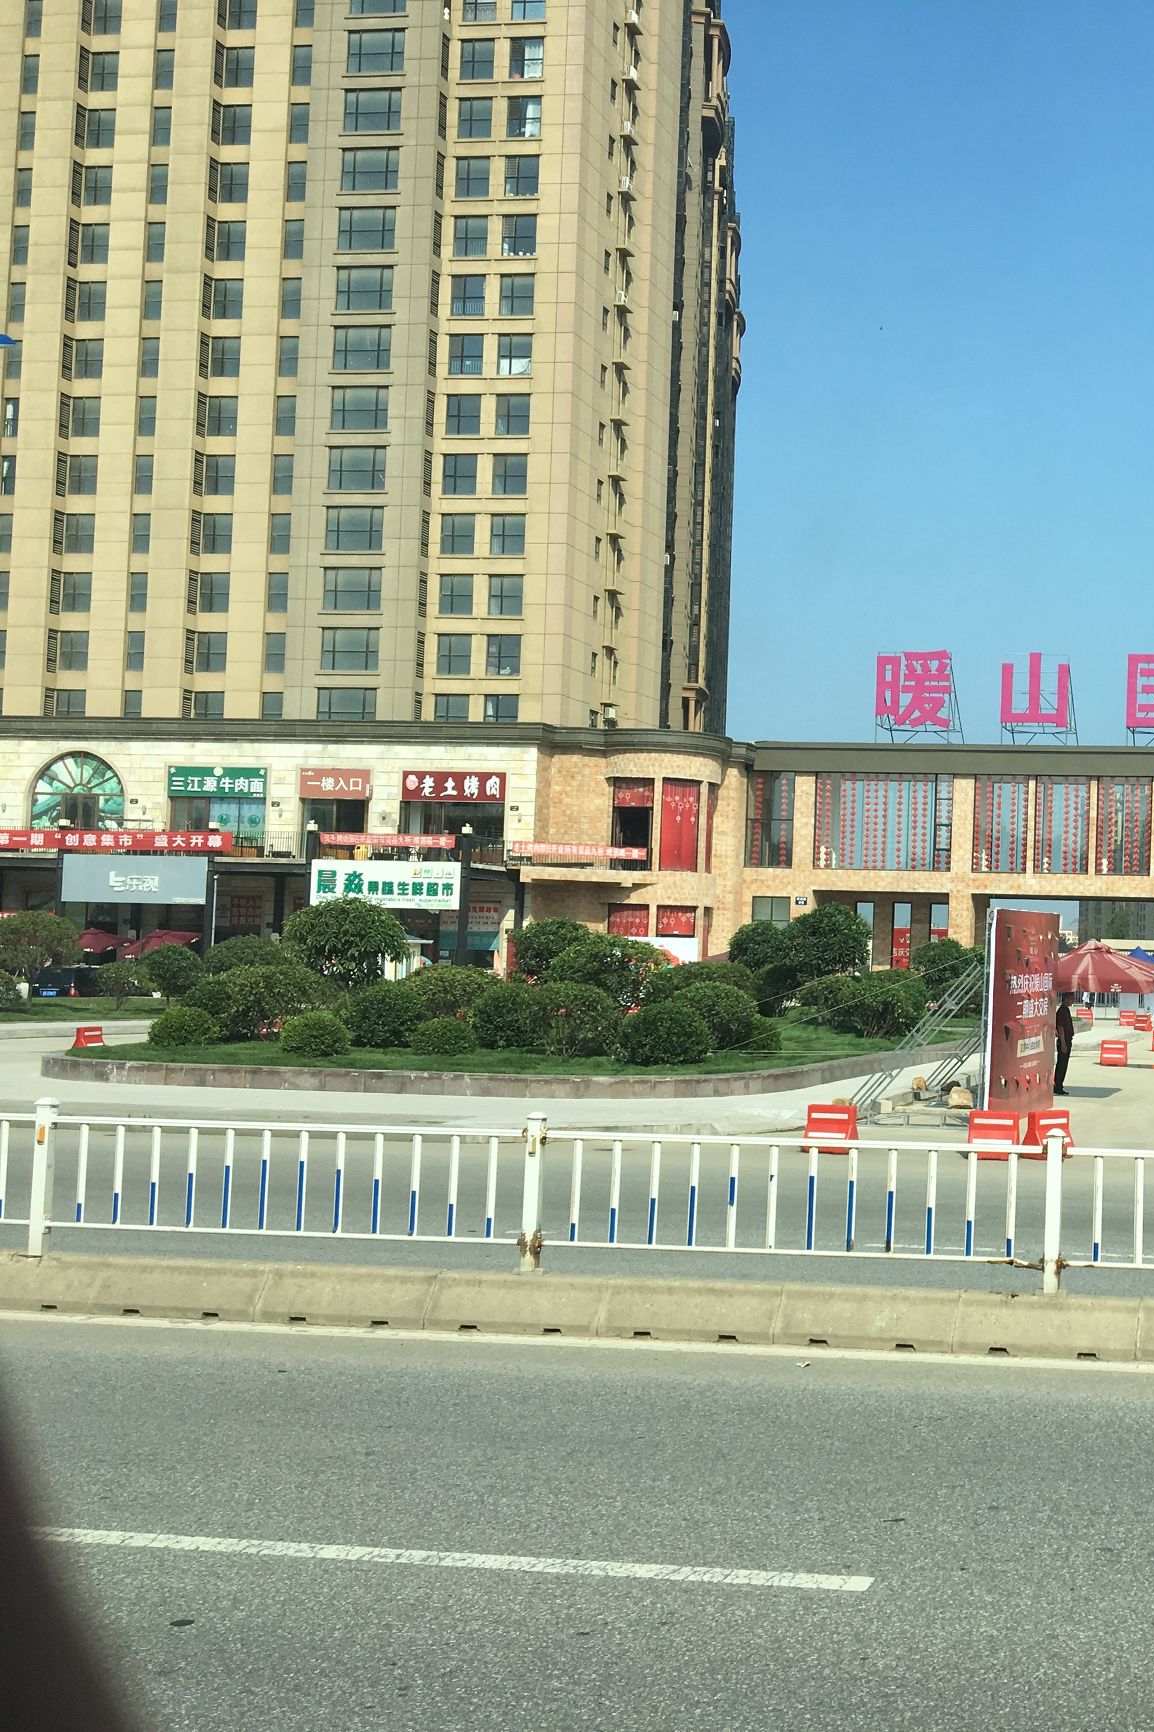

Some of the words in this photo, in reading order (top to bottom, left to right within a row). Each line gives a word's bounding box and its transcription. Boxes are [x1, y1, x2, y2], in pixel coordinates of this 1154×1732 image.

[170, 776, 264, 793] 三江源牛肉面
[306, 776, 362, 791] 一楼入口
[420, 774, 500, 799] 老土烤肉
[126, 875, 159, 893] 乐视
